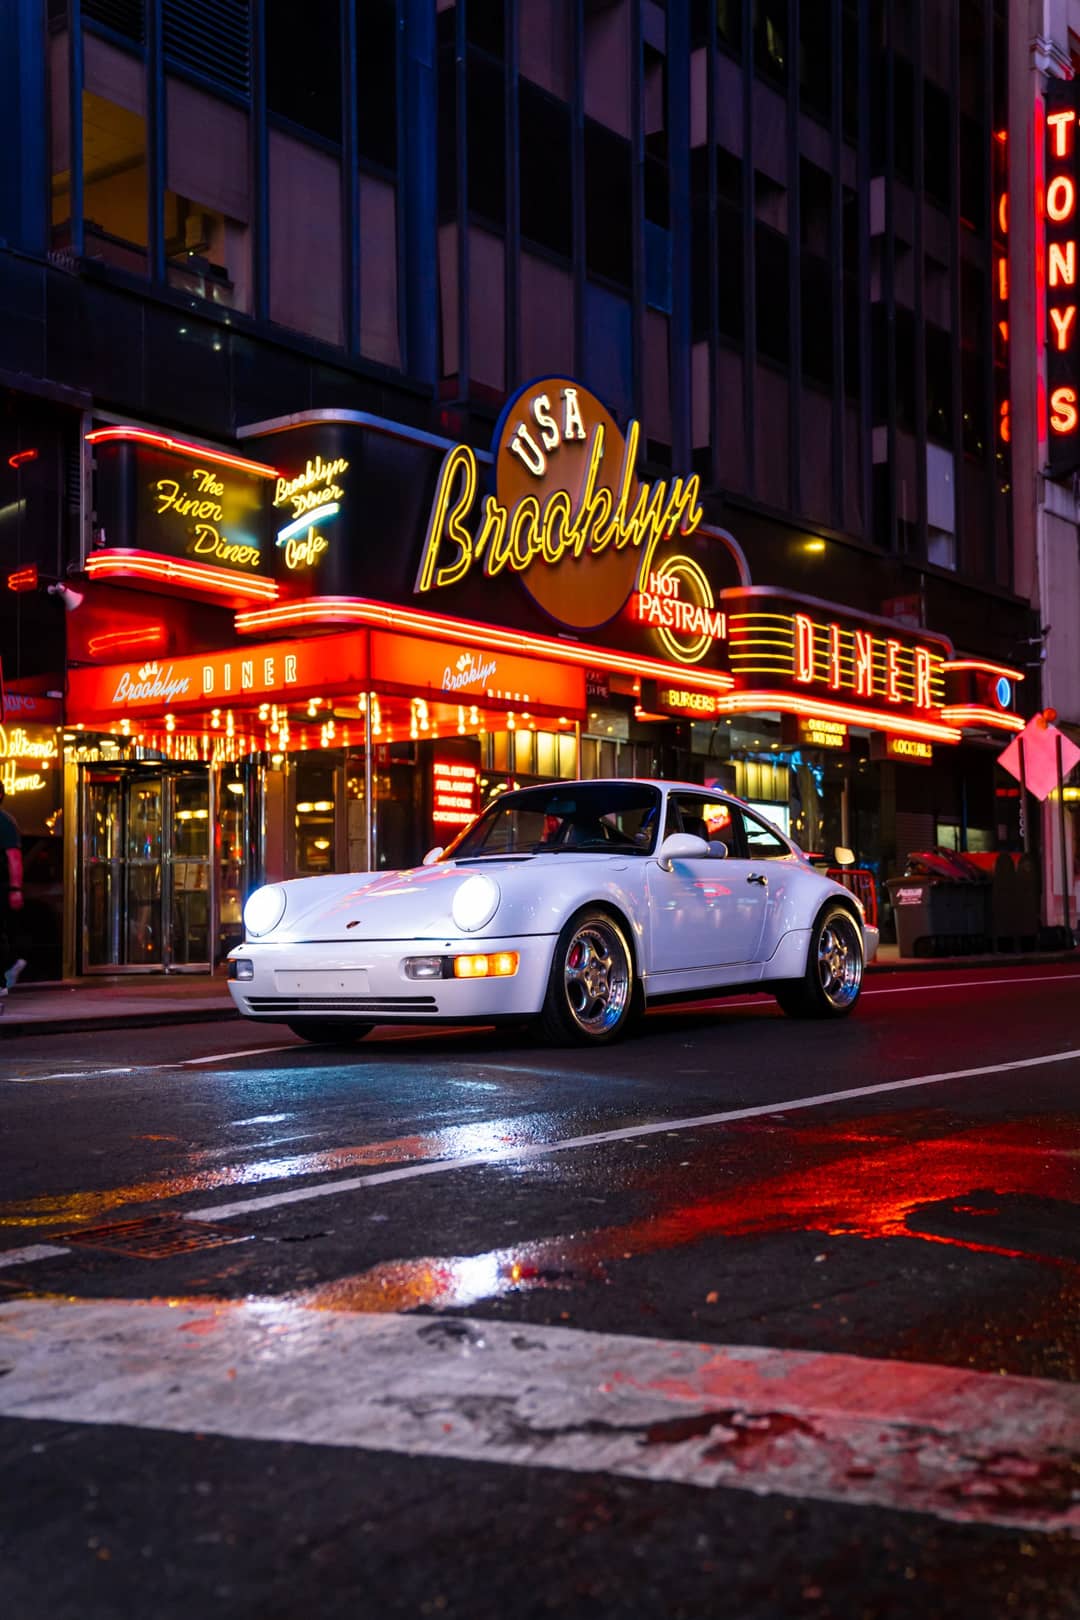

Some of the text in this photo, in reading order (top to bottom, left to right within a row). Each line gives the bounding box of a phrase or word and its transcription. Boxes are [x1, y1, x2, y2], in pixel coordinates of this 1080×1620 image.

[1047, 111, 1077, 432] TONYS
[509, 387, 587, 476] USA
[156, 479, 224, 522] Finer
[192, 468, 225, 497] The
[271, 454, 350, 507] Brooklyn
[290, 483, 345, 520] Diner
[414, 419, 703, 593] Brooklyn
[193, 523, 261, 567] Diner
[285, 525, 329, 570] Cafe
[649, 570, 681, 599] HOT
[638, 592, 727, 640] PASTRAMI
[111, 654, 297, 704] Brooklyn DINER
[440, 653, 497, 692] Brooklyn
[794, 614, 931, 709] DINER
[668, 690, 715, 711] BURGERS
[2, 759, 46, 796] Home
